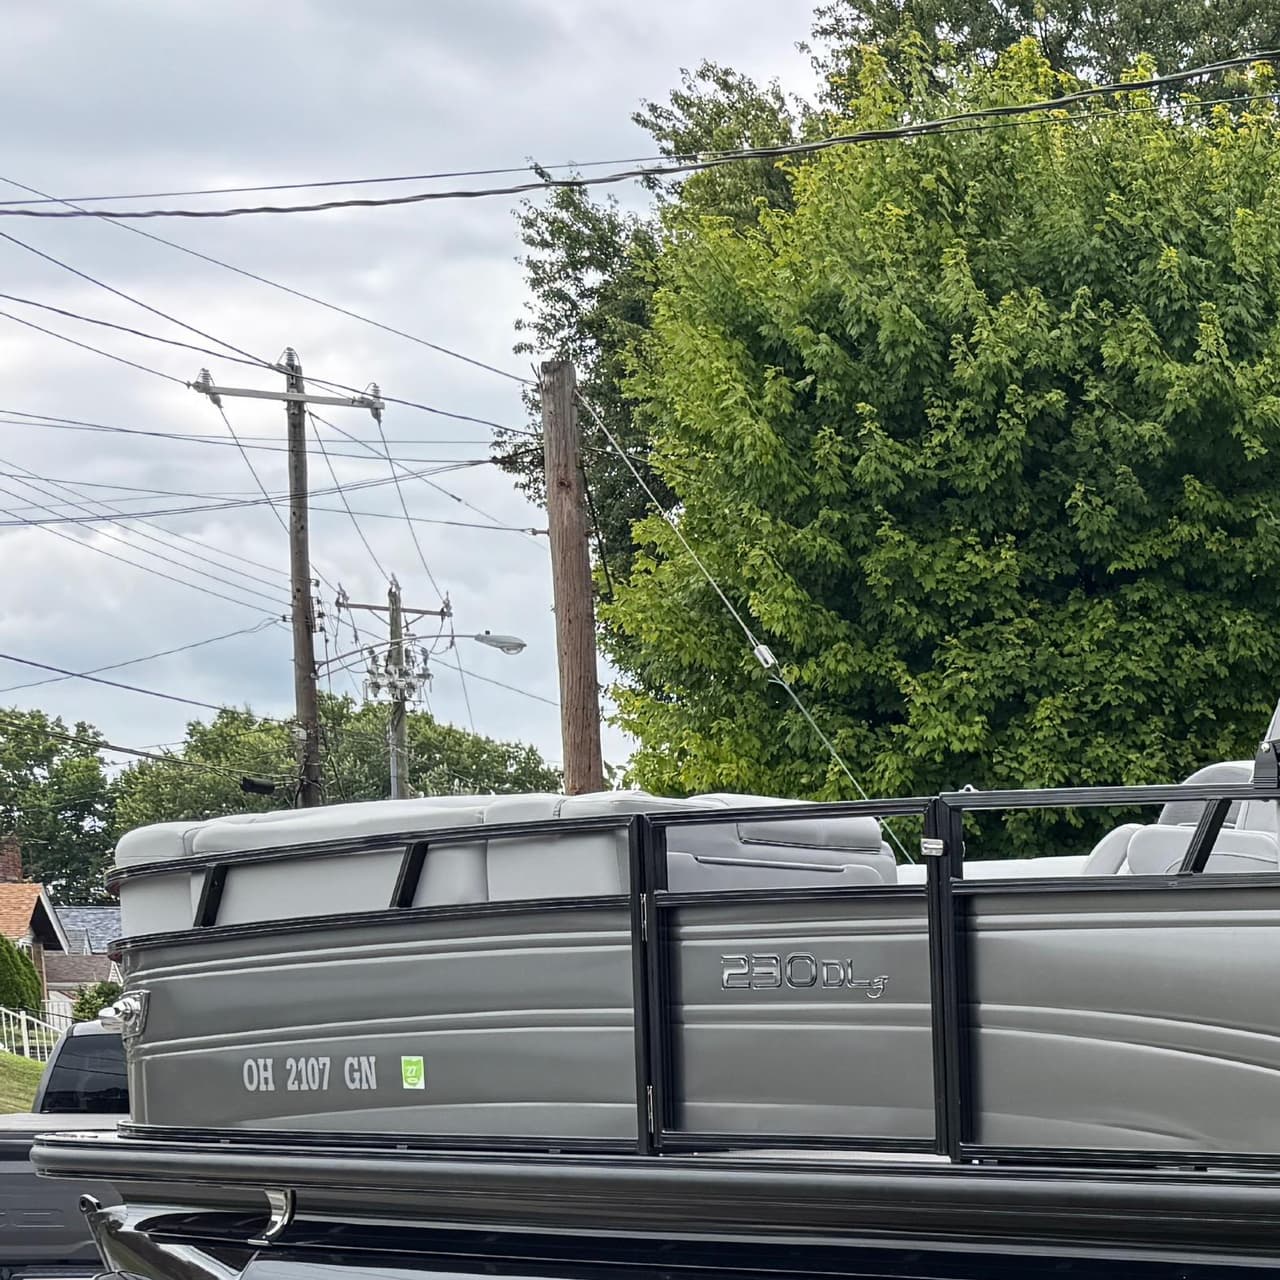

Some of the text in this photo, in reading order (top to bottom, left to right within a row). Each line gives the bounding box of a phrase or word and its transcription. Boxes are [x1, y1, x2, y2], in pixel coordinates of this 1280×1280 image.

[242, 1055, 377, 1091] OH 2107 GN
